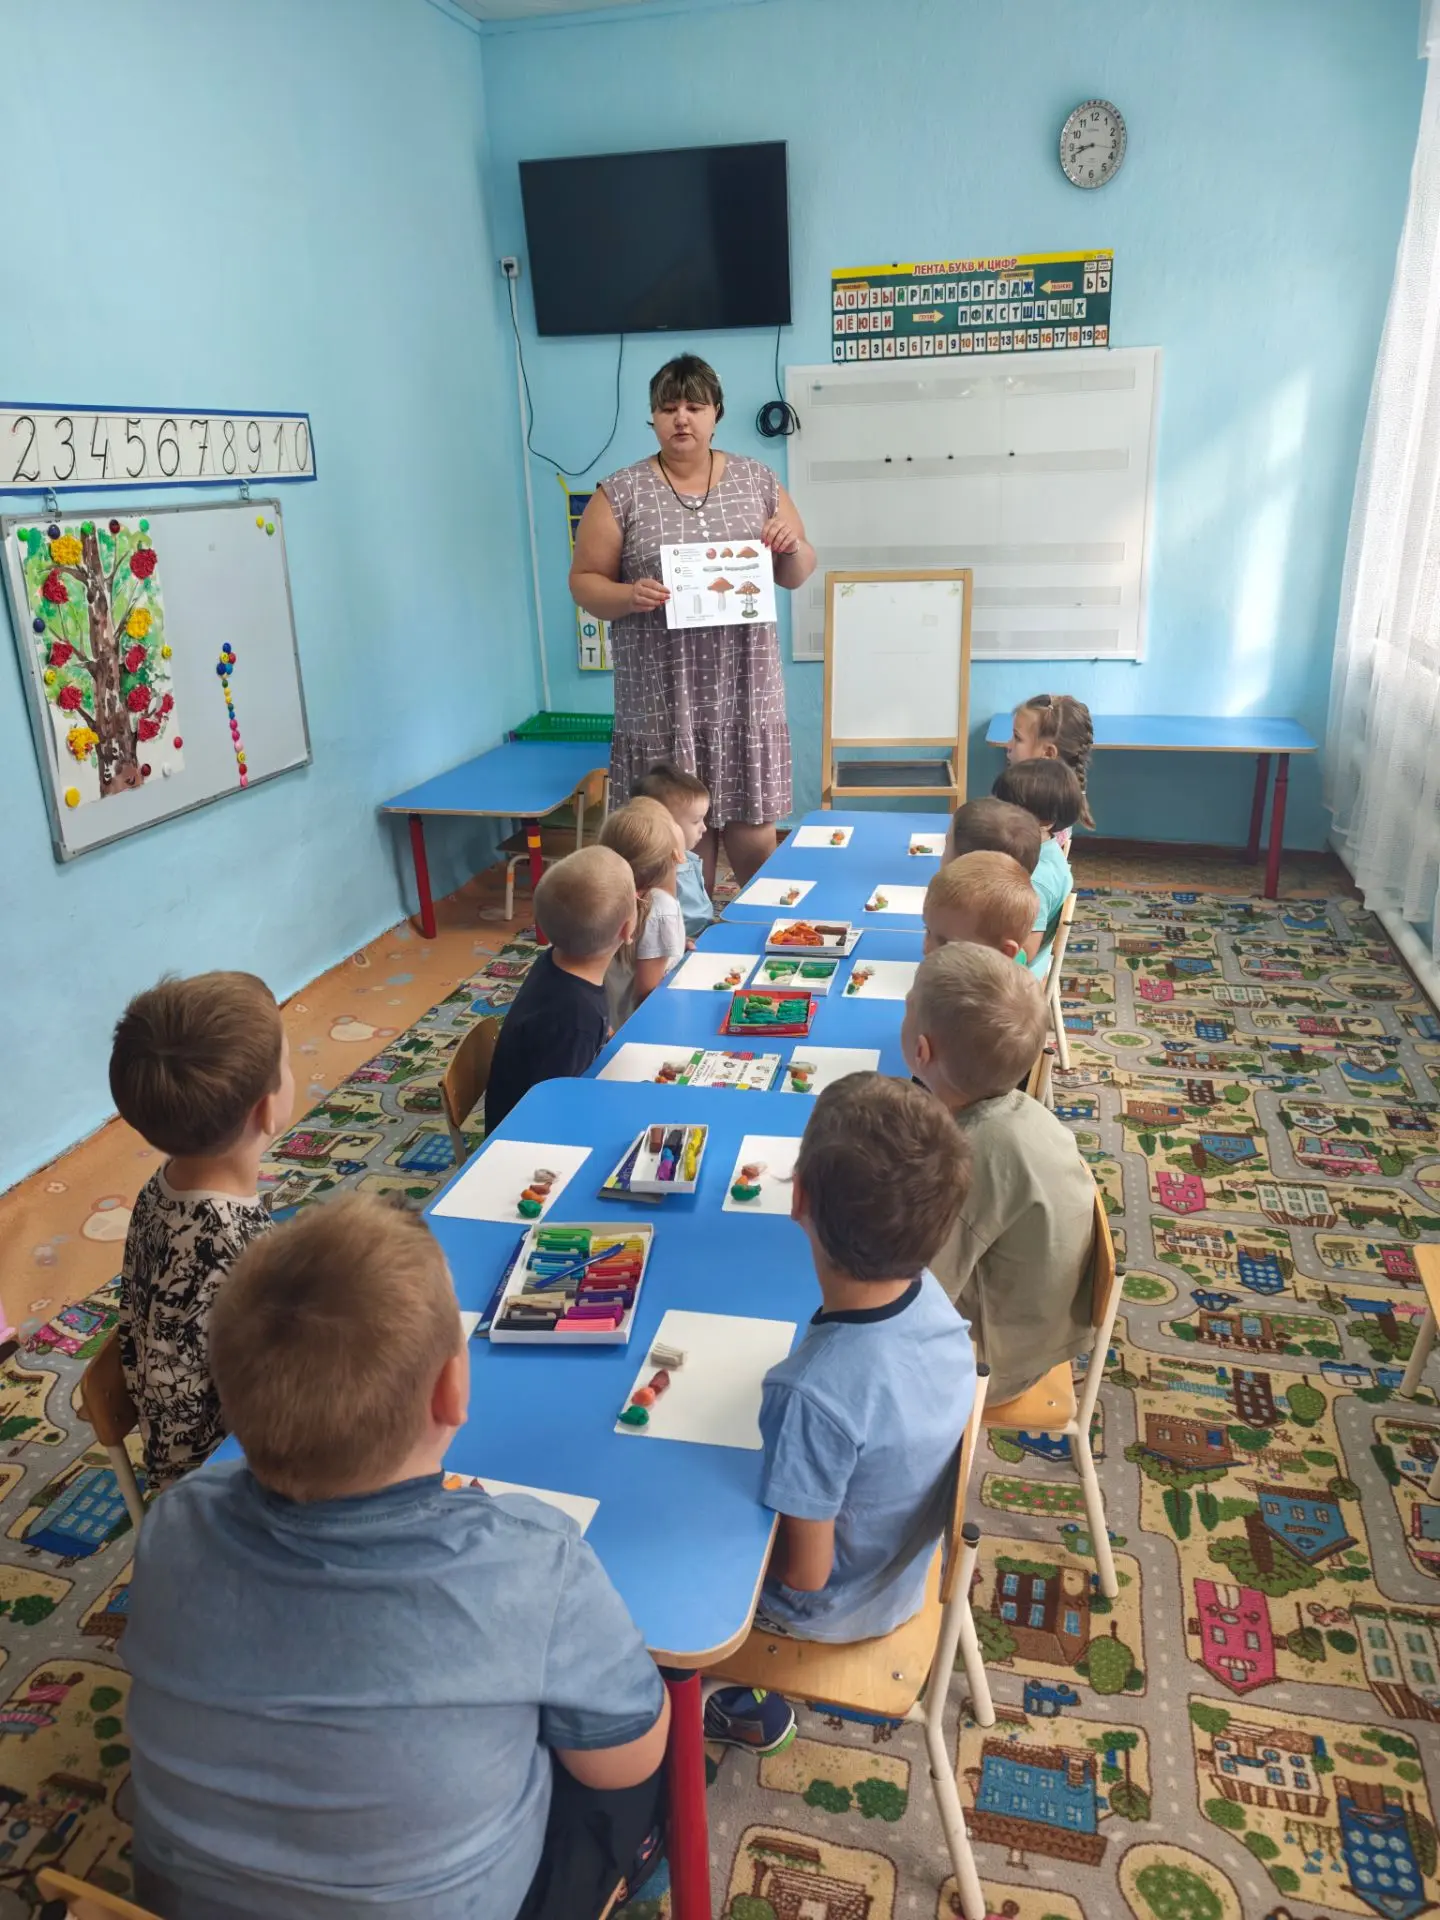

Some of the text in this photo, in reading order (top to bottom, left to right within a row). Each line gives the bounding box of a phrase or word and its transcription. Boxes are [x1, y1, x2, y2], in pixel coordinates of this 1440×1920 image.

[1091, 112, 1099, 121] 12
[1104, 117, 1107, 125] 1
[1080, 119, 1086, 128] 11
[1110, 128, 1115, 136] 2
[1070, 143, 1074, 151] 9
[1112, 140, 1116, 149] 3
[1102, 163, 1106, 171] 5
[1089, 170, 1094, 178] 6
[914, 259, 1017, 274] ЛЕНТА БУКВ И ЦИФР
[836, 295, 843, 307] А
[848, 293, 854, 306] О
[861, 293, 867, 305] У
[882, 291, 893, 303] Ы
[911, 290, 917, 302] Р
[923, 288, 930, 301] Л
[935, 288, 943, 300] М
[948, 287, 955, 300] Н
[961, 286, 968, 299] Б
[974, 285, 981, 297] В
[988, 284, 994, 296] Г
[1011, 282, 1020, 297] Д
[1023, 281, 1034, 294] Ж
[960, 302, 1084, 323] П Ф К С Т Ш Ц Ч Щ Х
[836, 315, 891, 331] Я Ё Ю Е И
[836, 330, 1106, 356] 0 1 2 3 4 5 6 7 8 9 10 11 12 13 14 15 16 17 18 19 20
[13, 416, 308, 482] 2 3 4 5 6 7 8 9 10
[583, 623, 596, 638] Ф
[586, 647, 596, 662] Т
